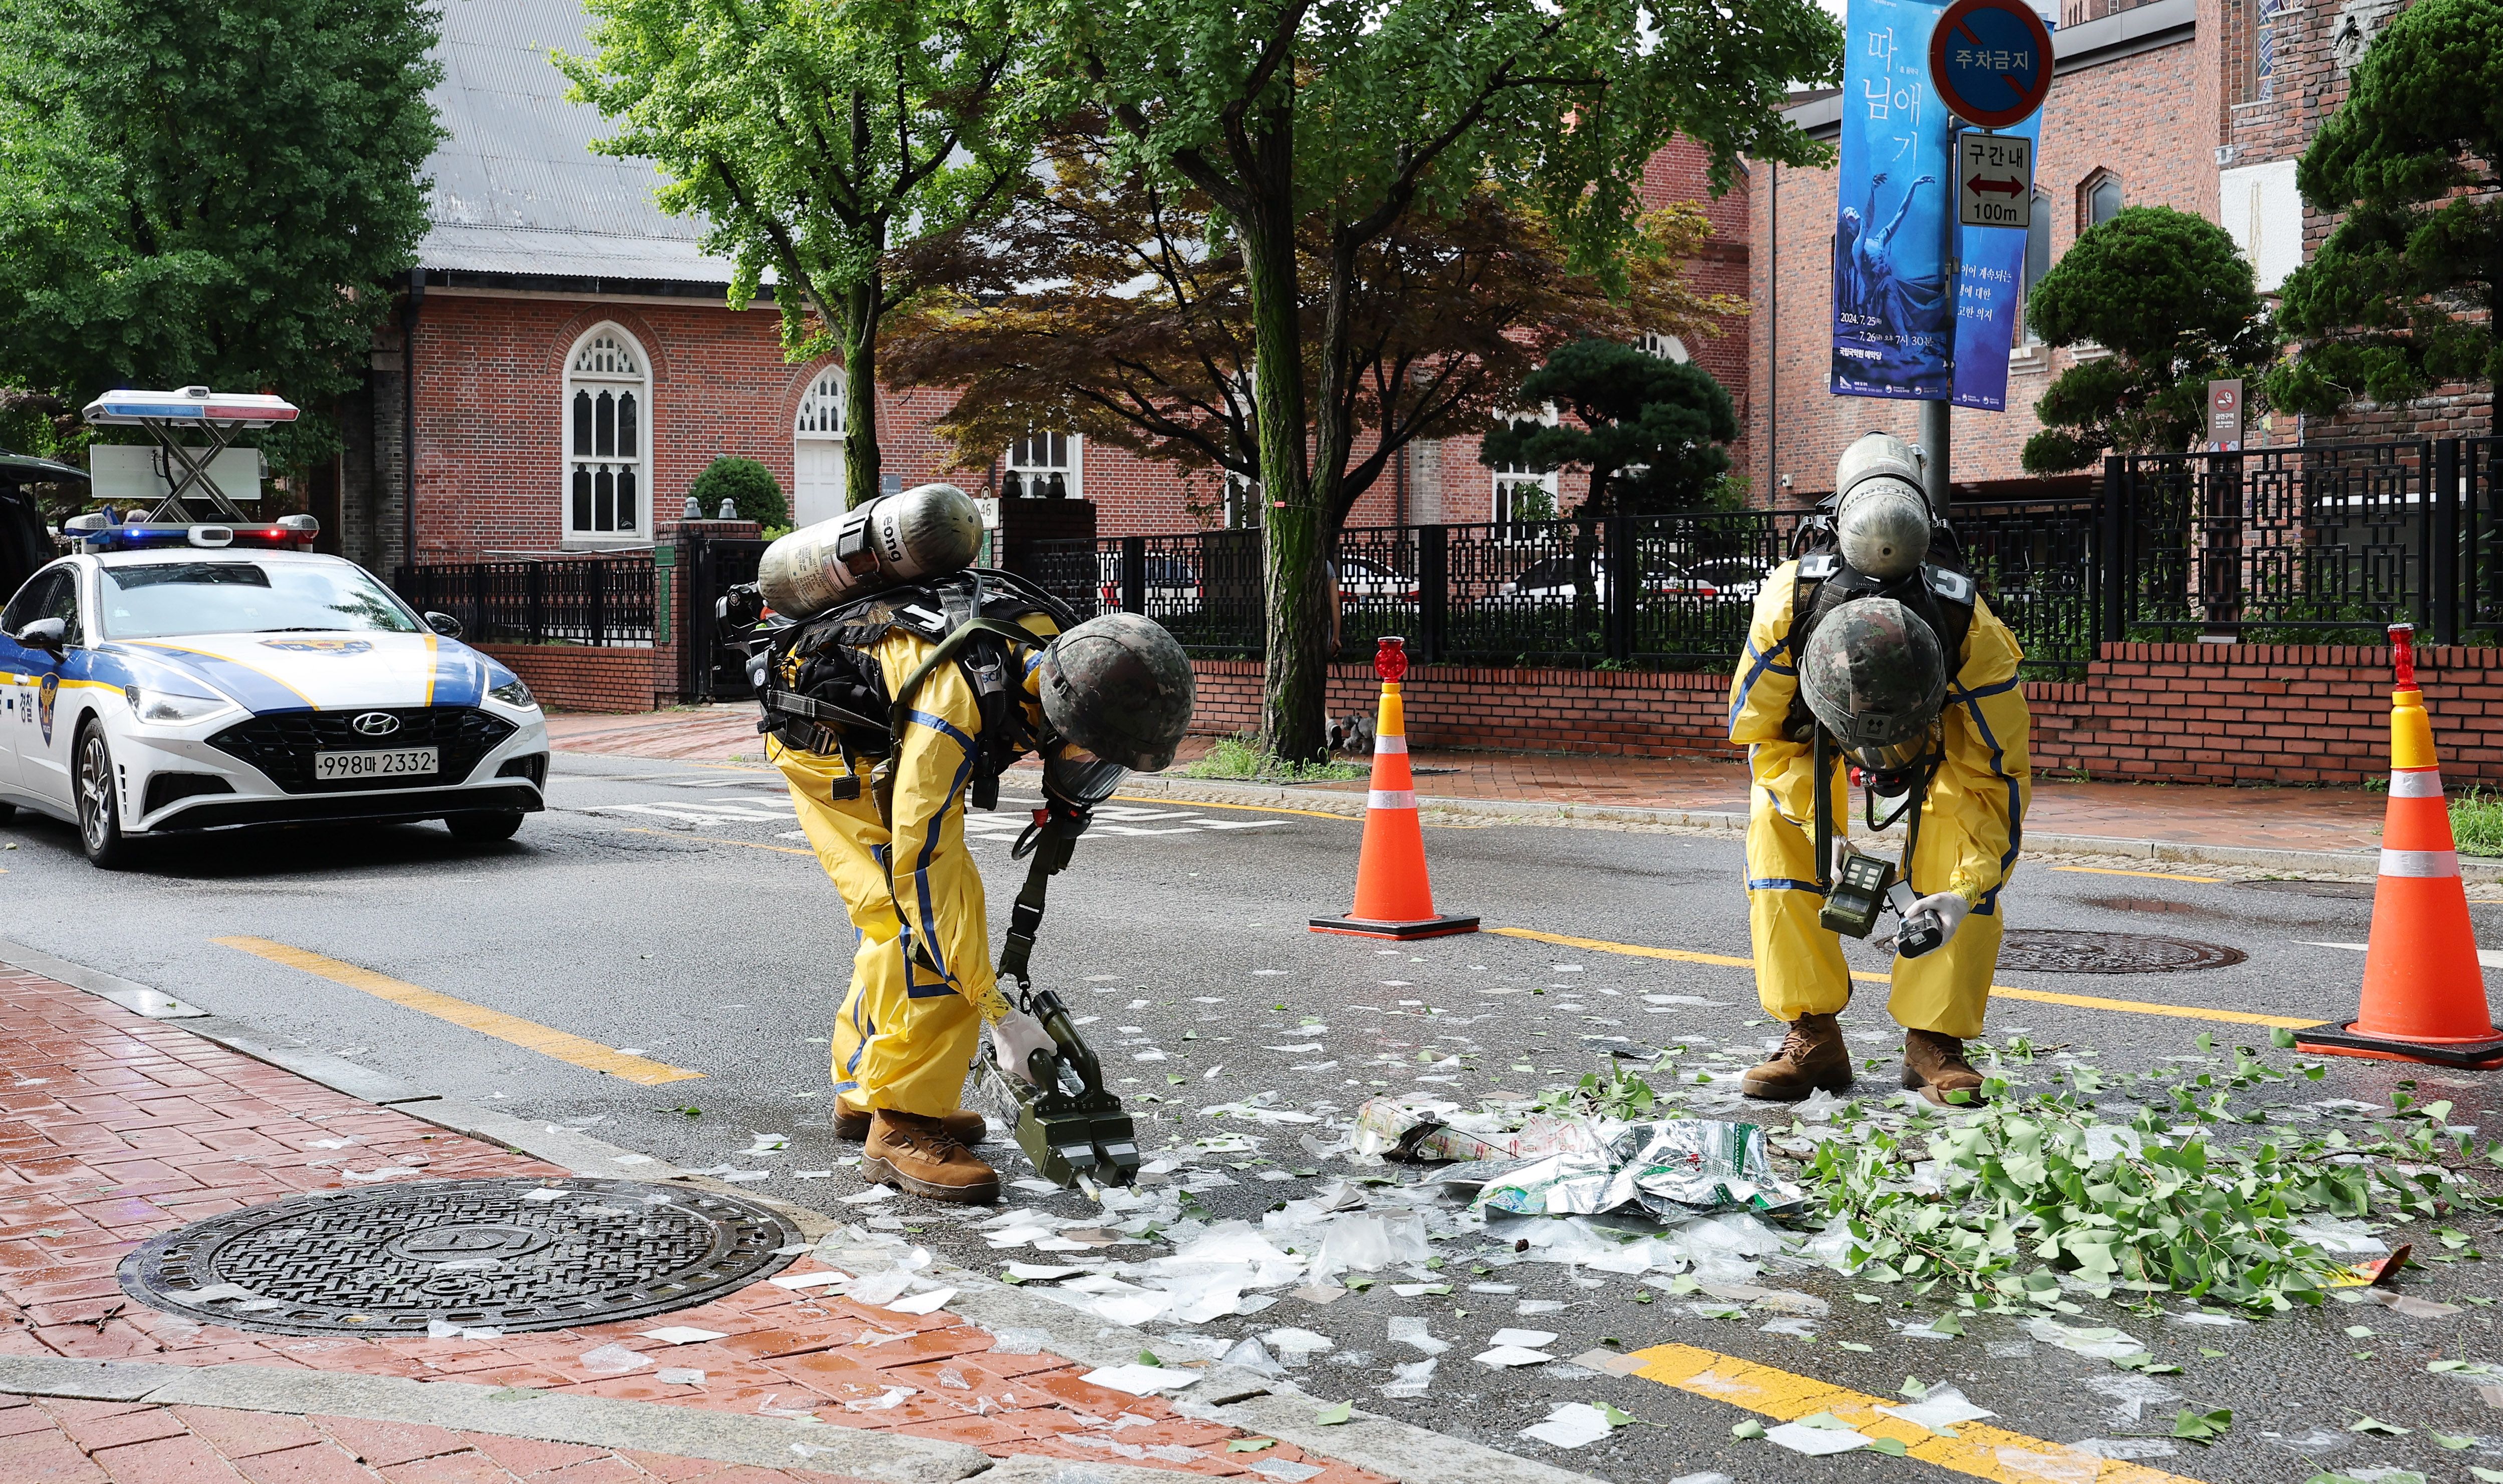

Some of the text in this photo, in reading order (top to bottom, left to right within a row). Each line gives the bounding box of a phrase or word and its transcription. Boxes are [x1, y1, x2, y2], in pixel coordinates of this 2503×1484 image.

[1956, 50, 2028, 70] 주차금지
[1969, 144, 2023, 168] 구간내
[1974, 203, 2017, 221] 100m
[1975, 287, 1991, 301] 대한
[1976, 308, 1992, 322] 의지
[1896, 335, 1908, 346] 7시
[1912, 336, 1933, 347] 30분
[1840, 347, 1882, 361] 국립국악원 예악당
[980, 503, 991, 516] 46
[20, 692, 33, 723] 경찰
[324, 752, 431, 775] 998마 2332
